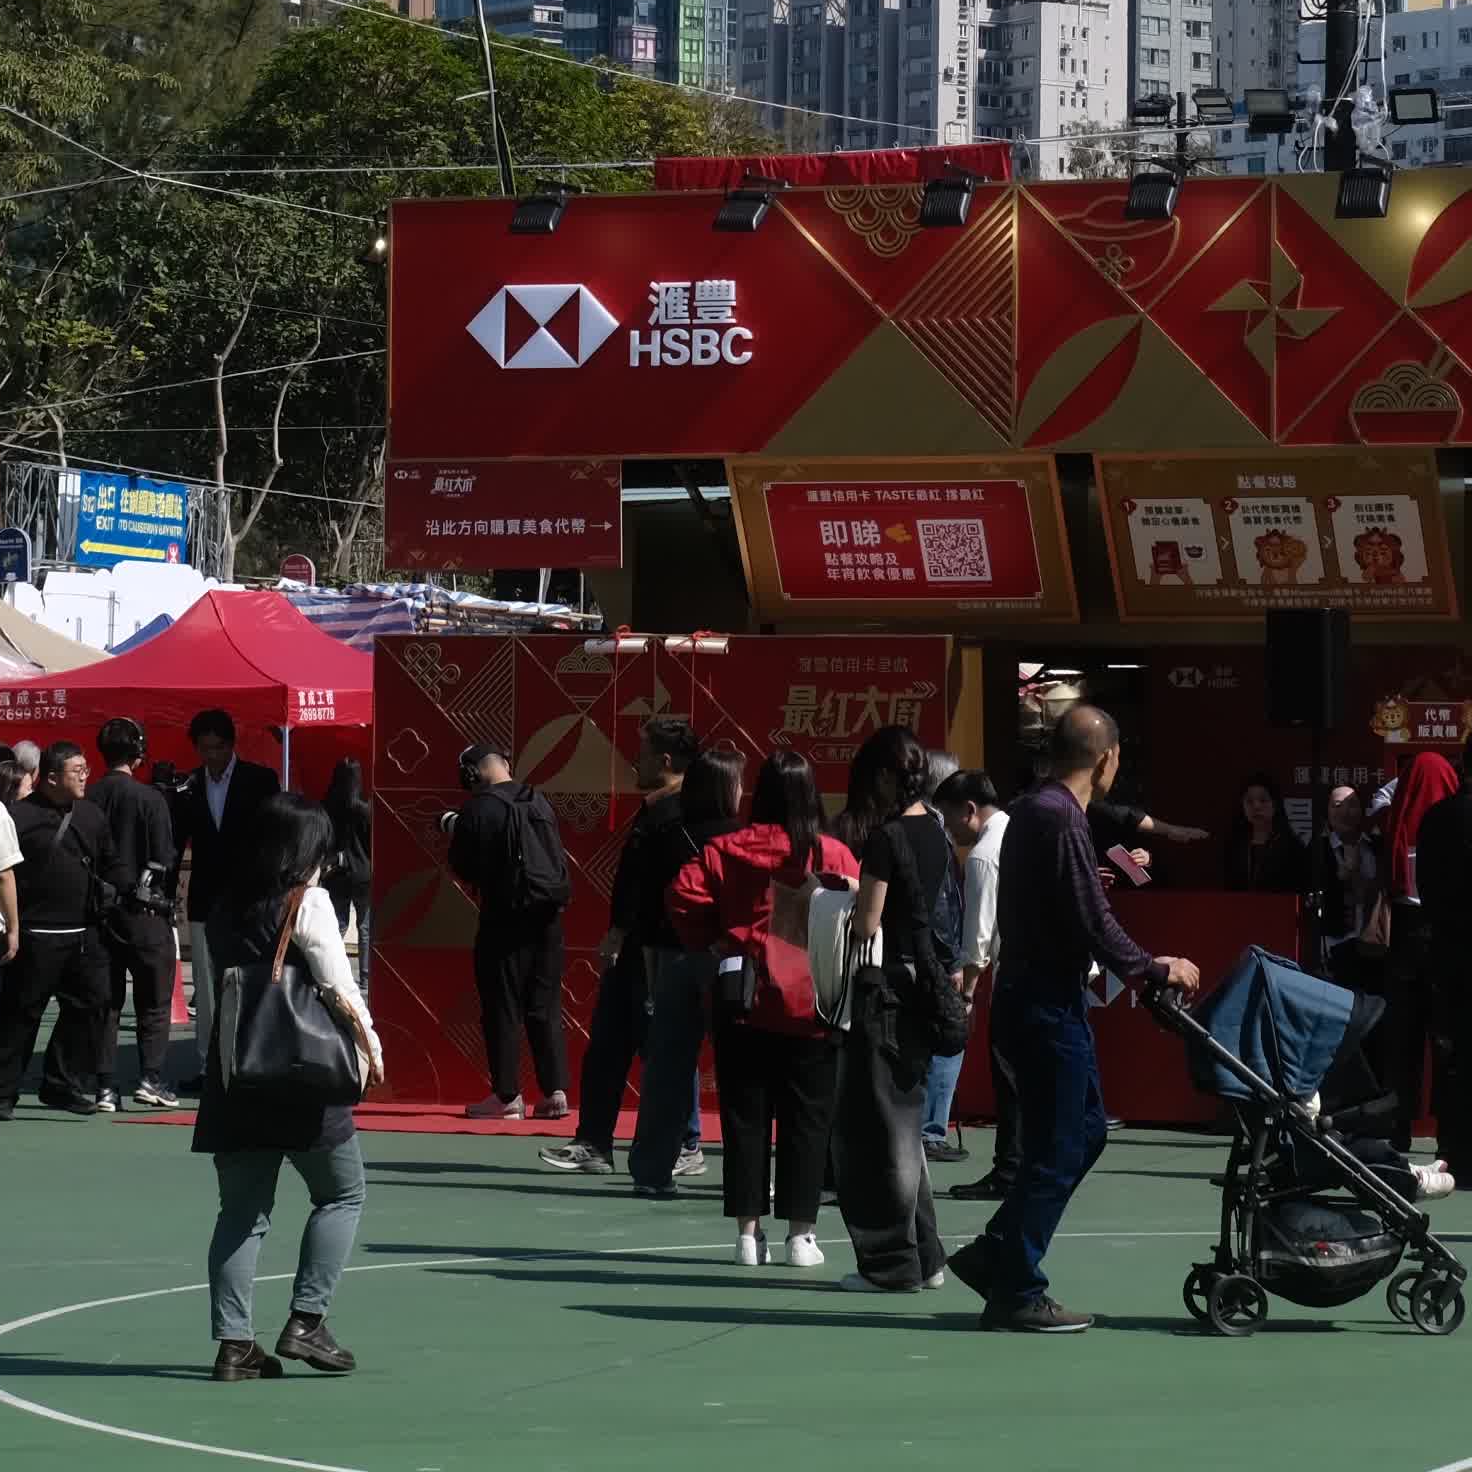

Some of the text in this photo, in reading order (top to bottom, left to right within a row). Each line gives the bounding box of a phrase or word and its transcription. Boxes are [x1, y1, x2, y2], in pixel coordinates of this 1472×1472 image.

[629, 327, 754, 367] HSBC
[1224, 500, 1233, 511] 2
[96, 515, 115, 532] EXIT
[425, 518, 586, 536] 沿此方向購買美食代幣
[819, 519, 881, 547] 即睇
[1424, 708, 1451, 722] 代幣
